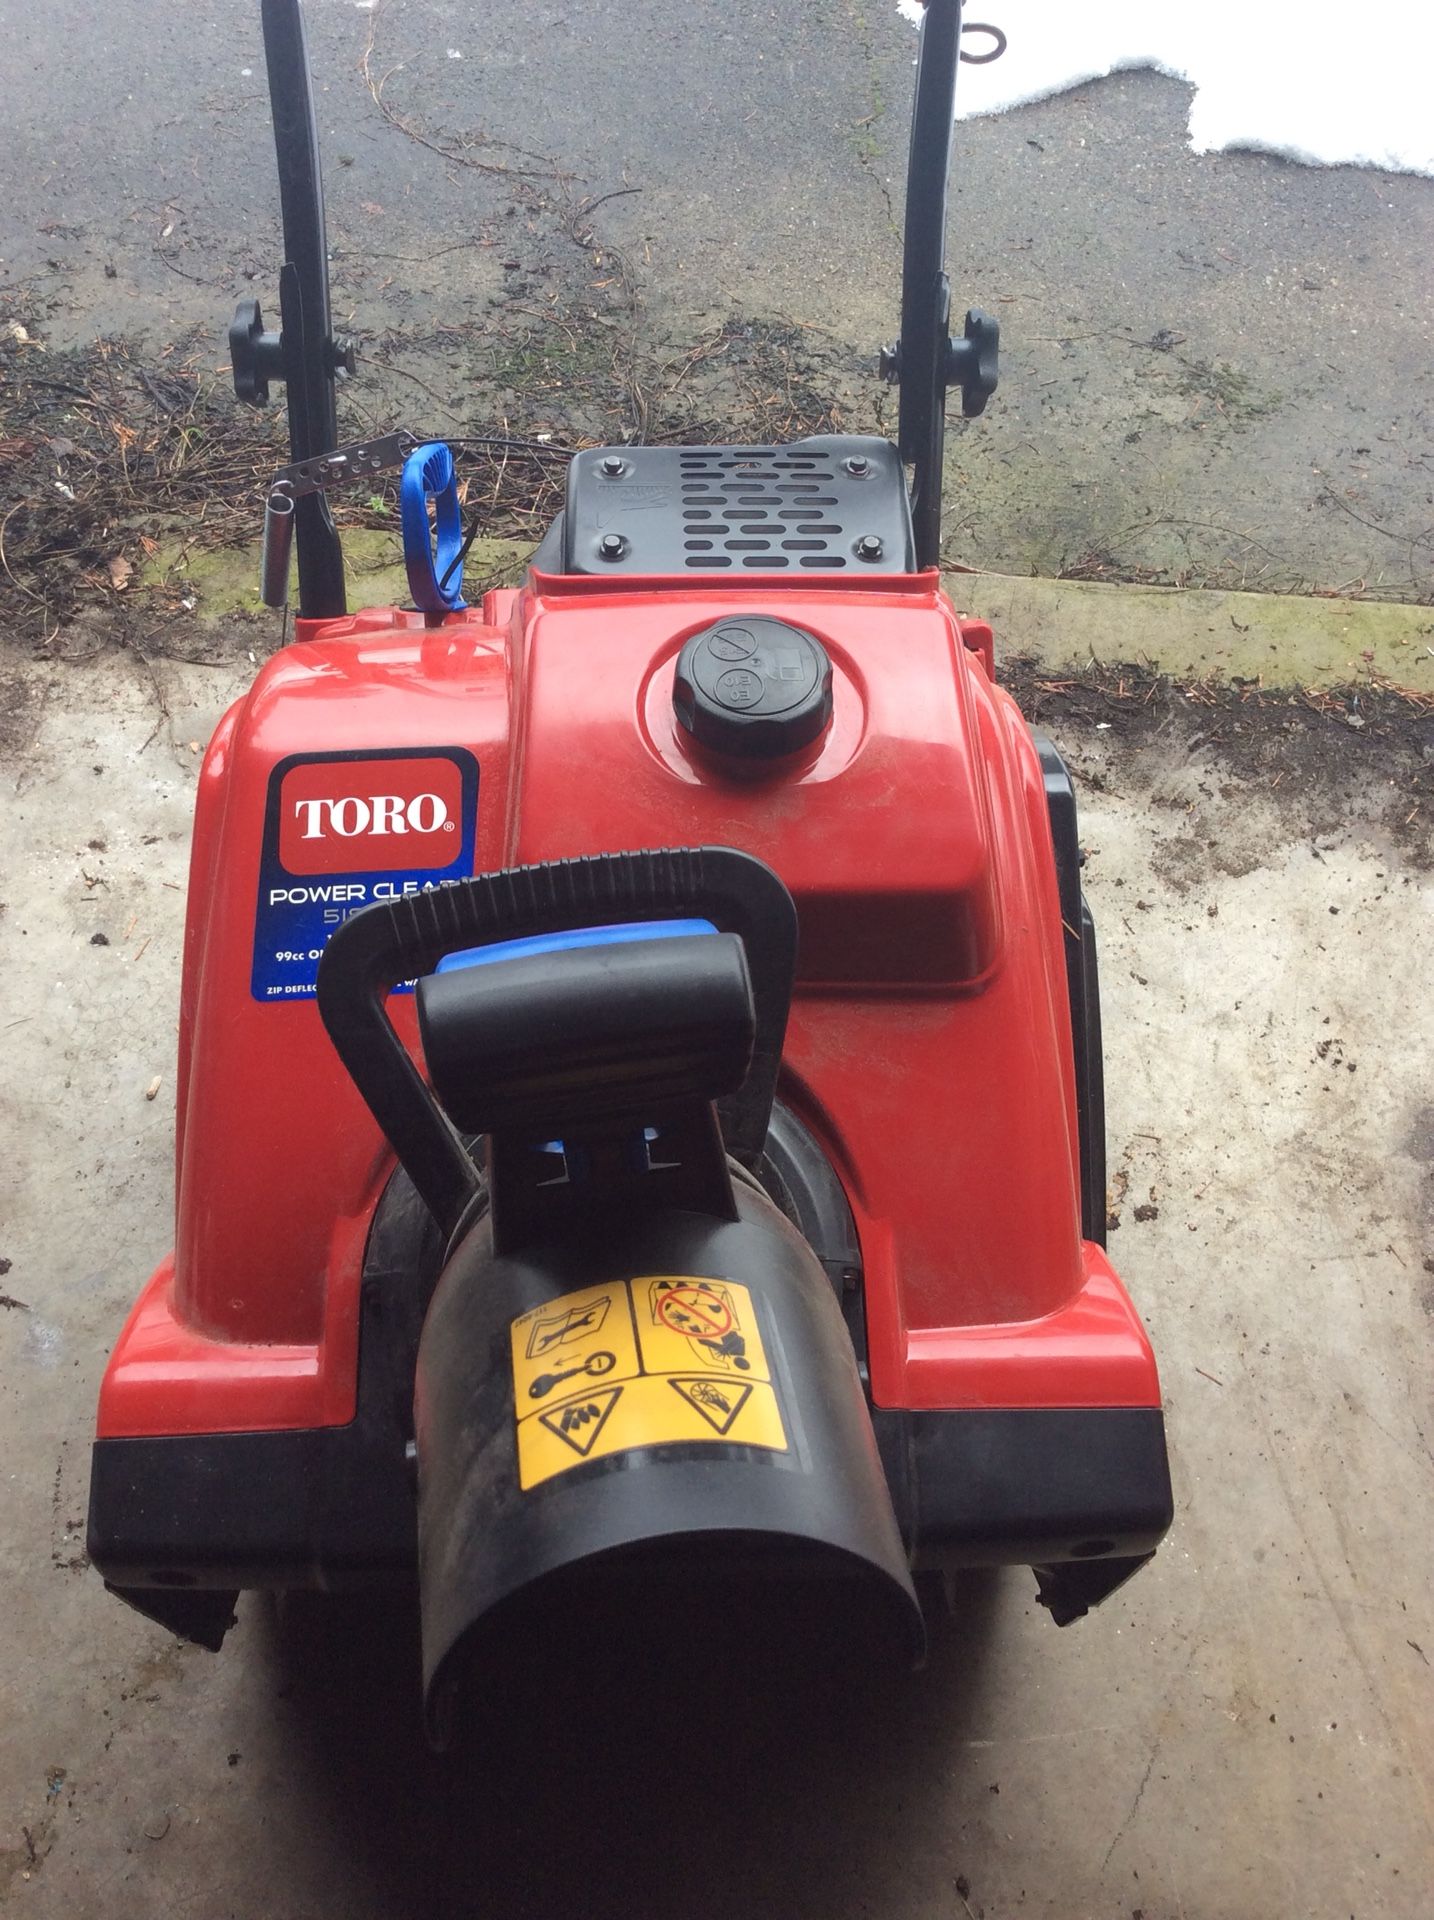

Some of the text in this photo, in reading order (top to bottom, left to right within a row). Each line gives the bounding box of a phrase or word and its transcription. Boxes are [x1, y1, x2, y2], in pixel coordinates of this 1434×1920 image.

[269, 884, 366, 906] POWER
[275, 951, 305, 962] 99cc
[267, 986, 283, 995] ZIP
